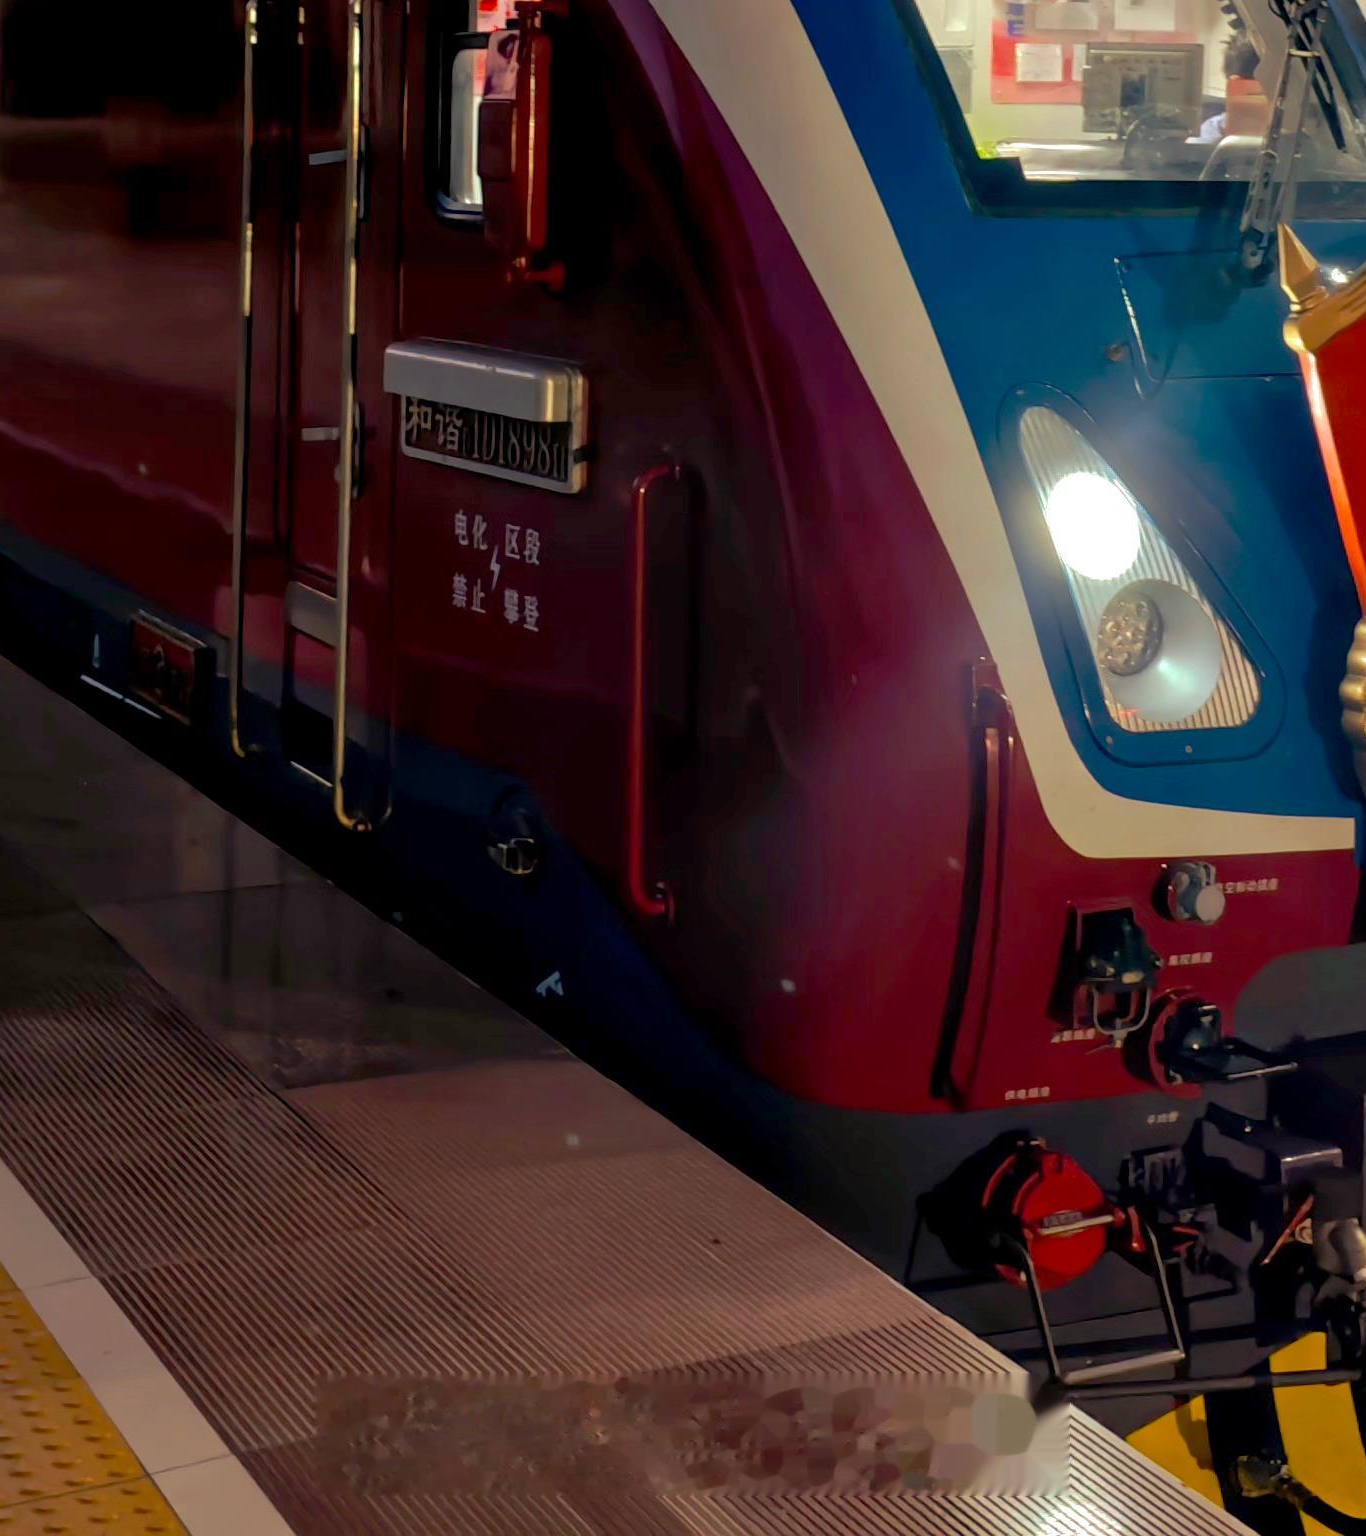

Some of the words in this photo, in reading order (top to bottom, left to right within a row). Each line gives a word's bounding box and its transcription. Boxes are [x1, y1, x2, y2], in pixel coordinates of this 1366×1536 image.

[454, 508, 489, 551] 电化
[504, 522, 540, 566] 区段
[452, 571, 487, 614] 禁止
[503, 587, 540, 632] 攀登
